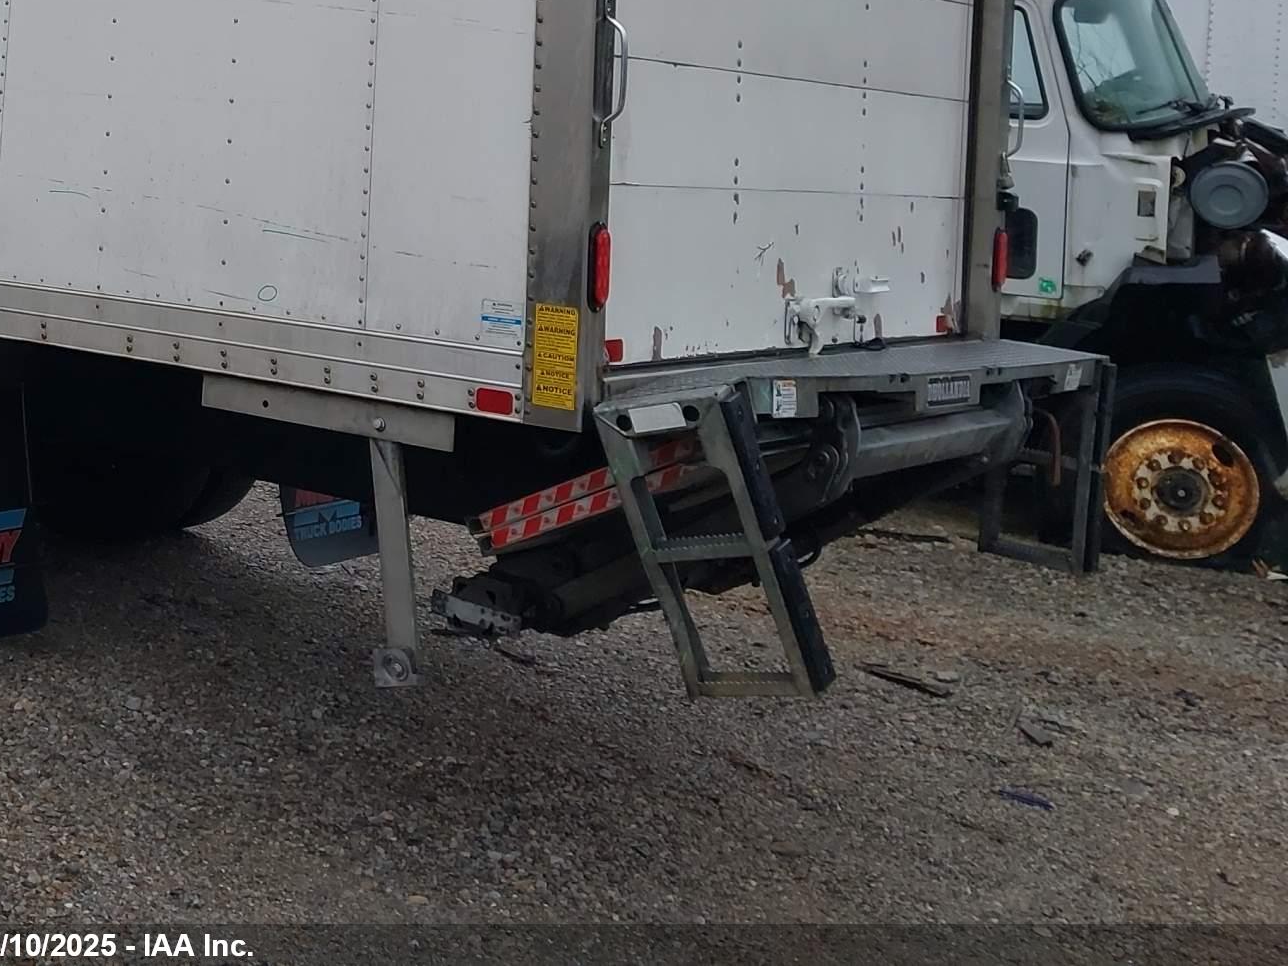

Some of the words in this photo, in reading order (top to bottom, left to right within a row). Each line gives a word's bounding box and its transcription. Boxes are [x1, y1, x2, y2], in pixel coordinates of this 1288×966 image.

[545, 306, 576, 315] WARNING
[544, 325, 575, 336] WARNING
[543, 353, 574, 362] CAUTION
[546, 370, 570, 379] NOTICE
[543, 385, 573, 395] NOTICE
[328, 515, 362, 534] BODIES
